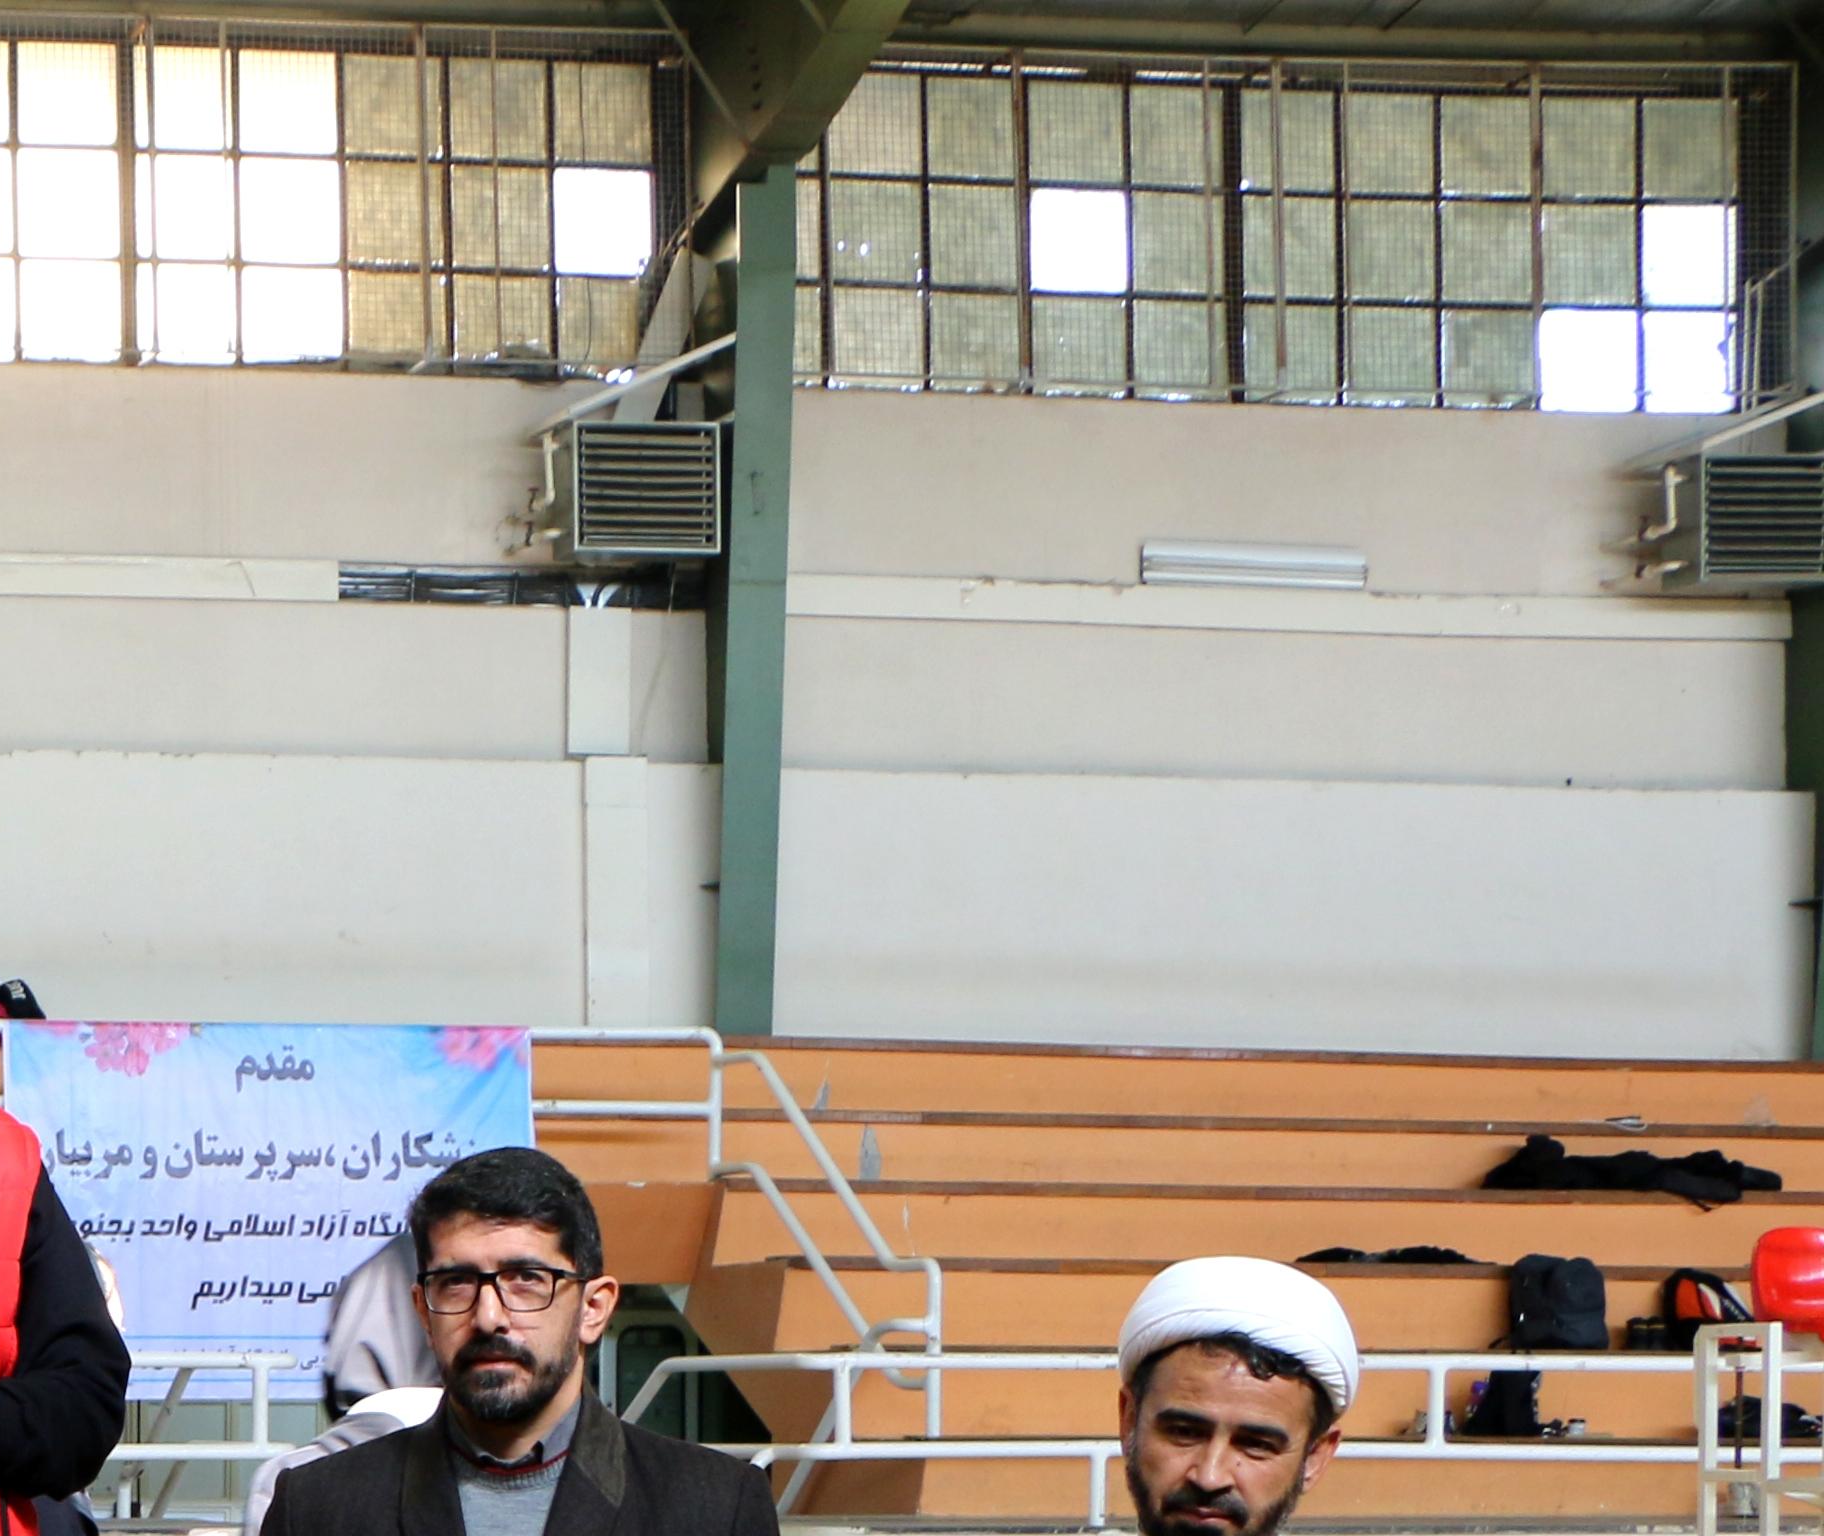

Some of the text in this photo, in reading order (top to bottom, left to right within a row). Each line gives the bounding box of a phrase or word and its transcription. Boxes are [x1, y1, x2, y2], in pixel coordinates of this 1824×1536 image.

[234, 1045, 316, 1093] مقدم
[139, 1145, 159, 1180] و
[342, 1130, 475, 1182] شکاران
[71, 1213, 136, 1242] بجنو
[140, 1213, 199, 1242] واحد
[202, 1213, 296, 1242] اسلامی
[300, 1208, 352, 1241] آزاد
[191, 1274, 294, 1310] میداریم
